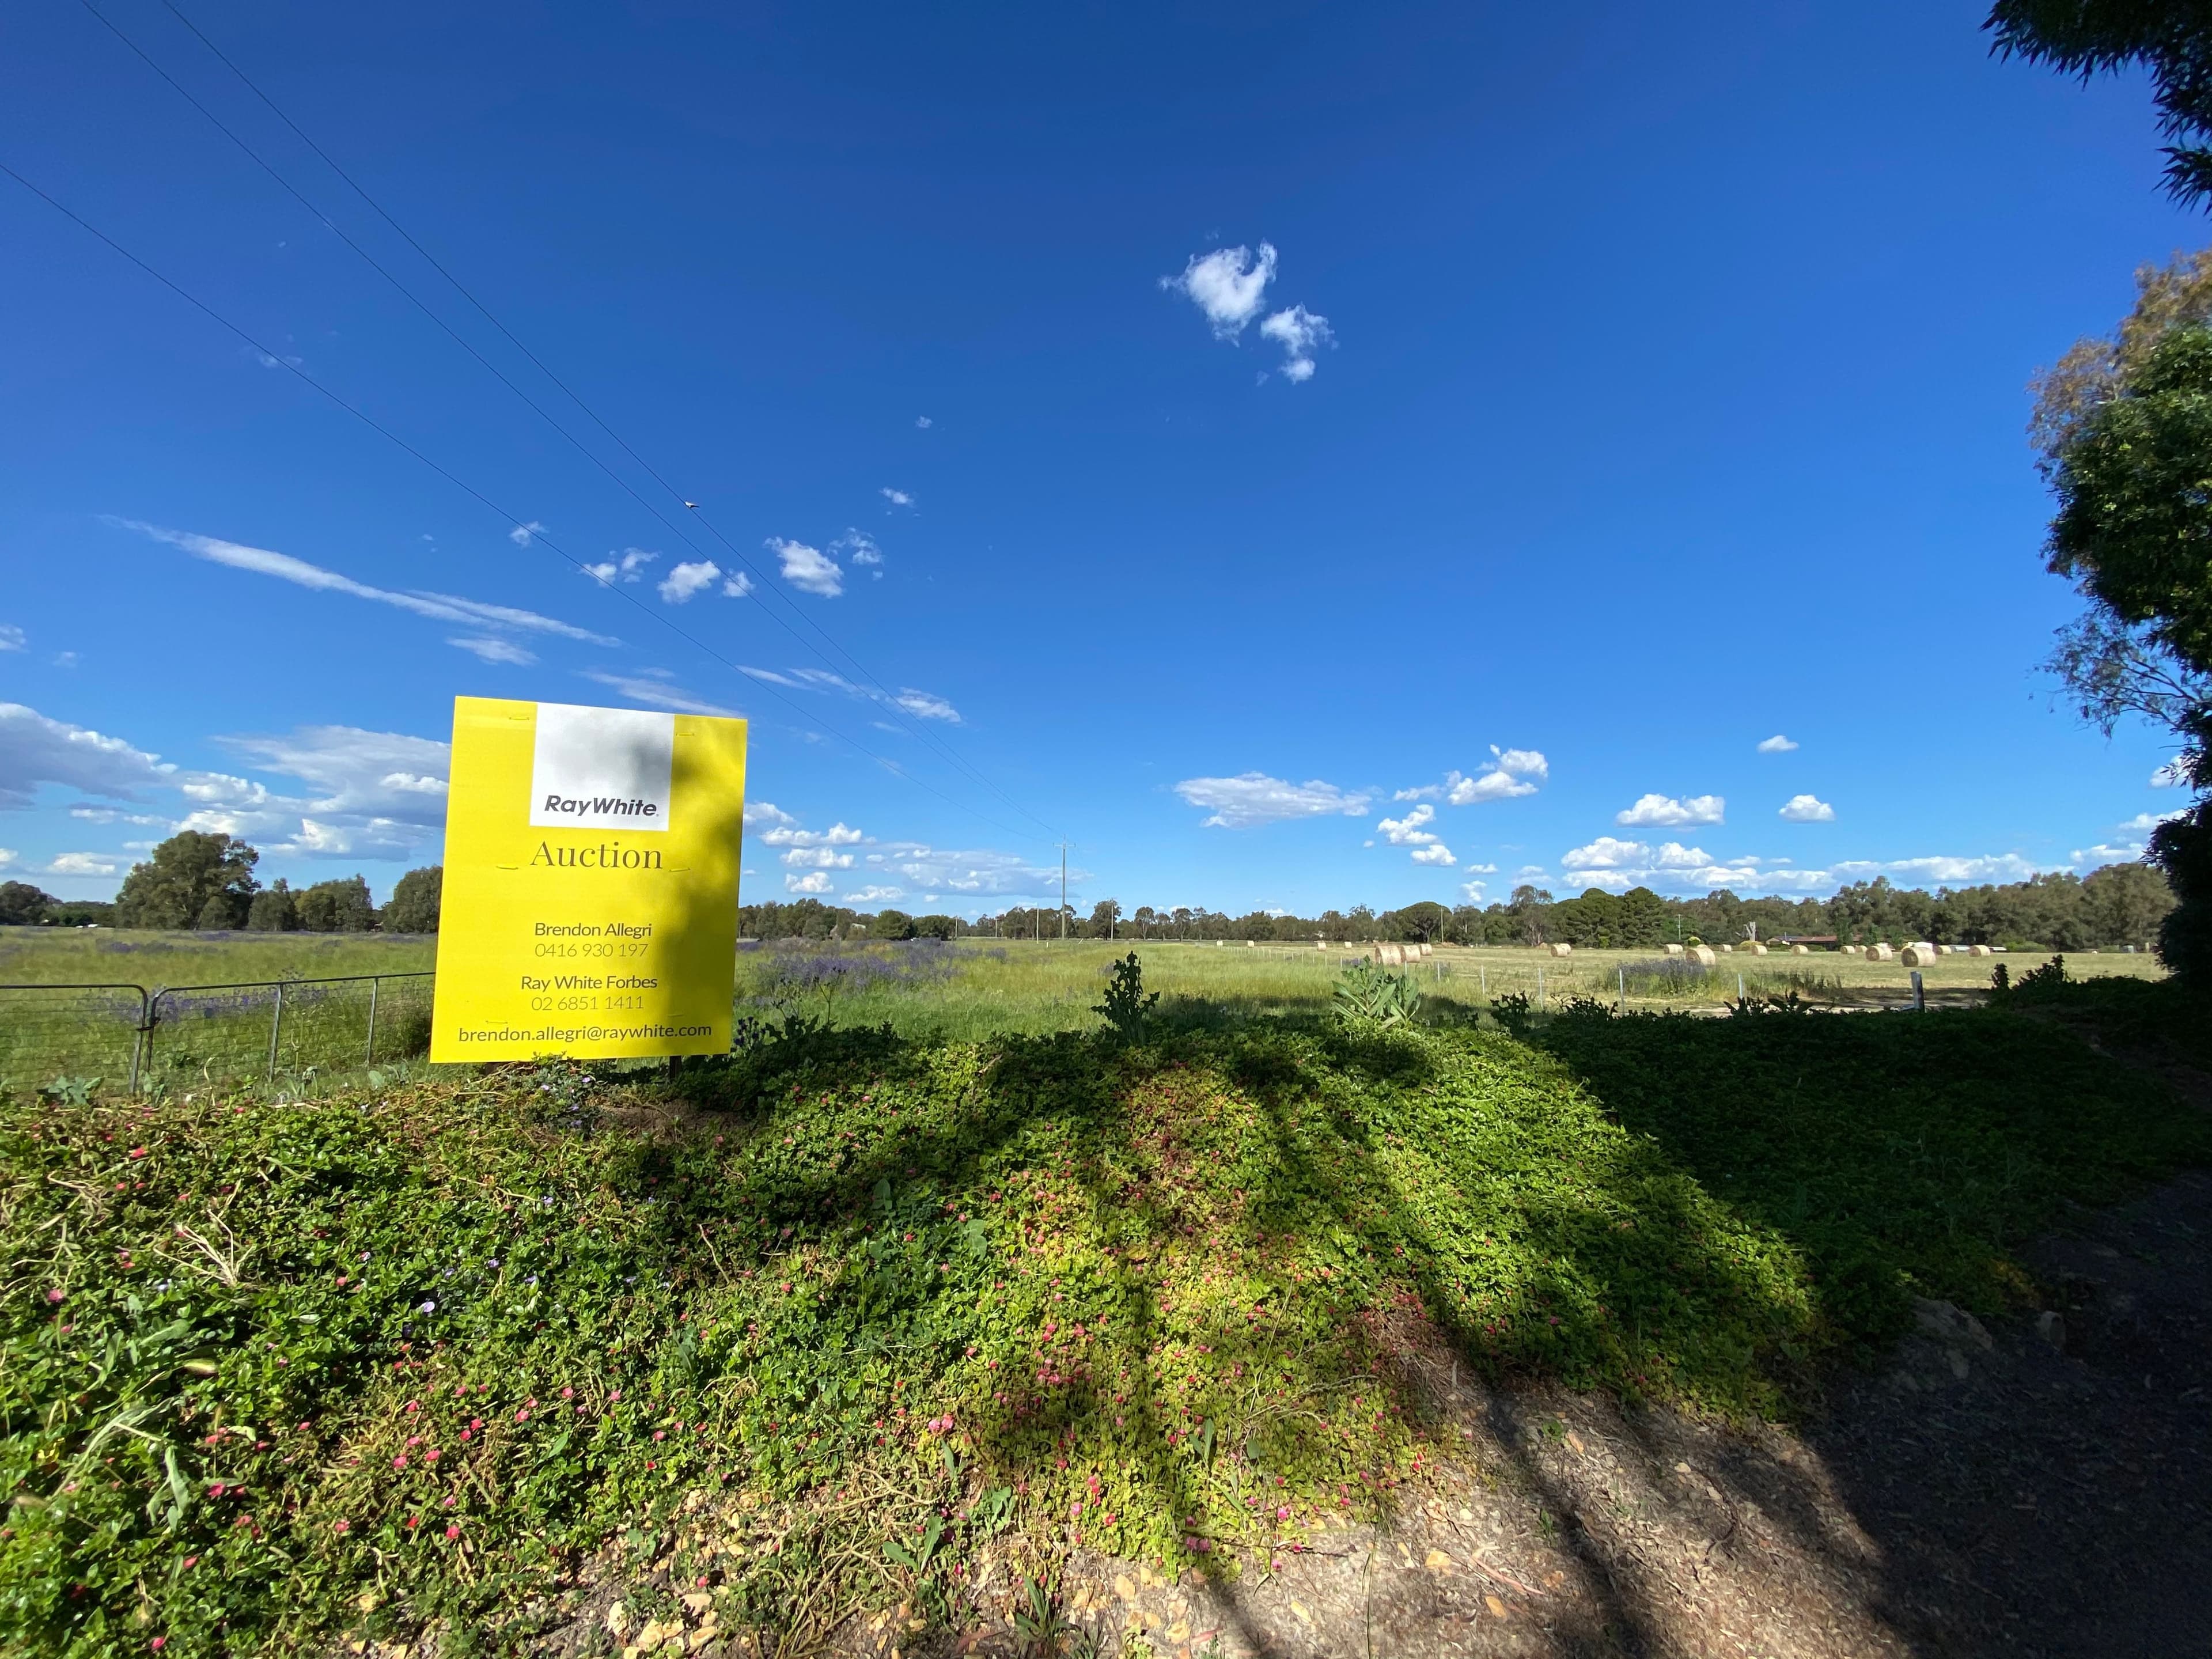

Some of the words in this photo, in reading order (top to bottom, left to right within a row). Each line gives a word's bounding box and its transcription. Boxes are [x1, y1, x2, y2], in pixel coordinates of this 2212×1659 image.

[544, 795, 658, 816] RayWhite
[531, 840, 663, 869] Auction
[535, 922, 601, 937] Brendon
[604, 923, 652, 940] Allegri
[535, 944, 577, 957] 0416
[582, 944, 613, 957] 930
[618, 944, 649, 957] 197
[521, 976, 551, 993] Ray
[554, 975, 603, 990] White
[607, 975, 658, 989] Forbes
[531, 997, 553, 1010] 02
[557, 996, 599, 1010] 6851
[605, 995, 643, 1009] 1411
[459, 1024, 712, 1043] brendon.allegri@raywhite.com
